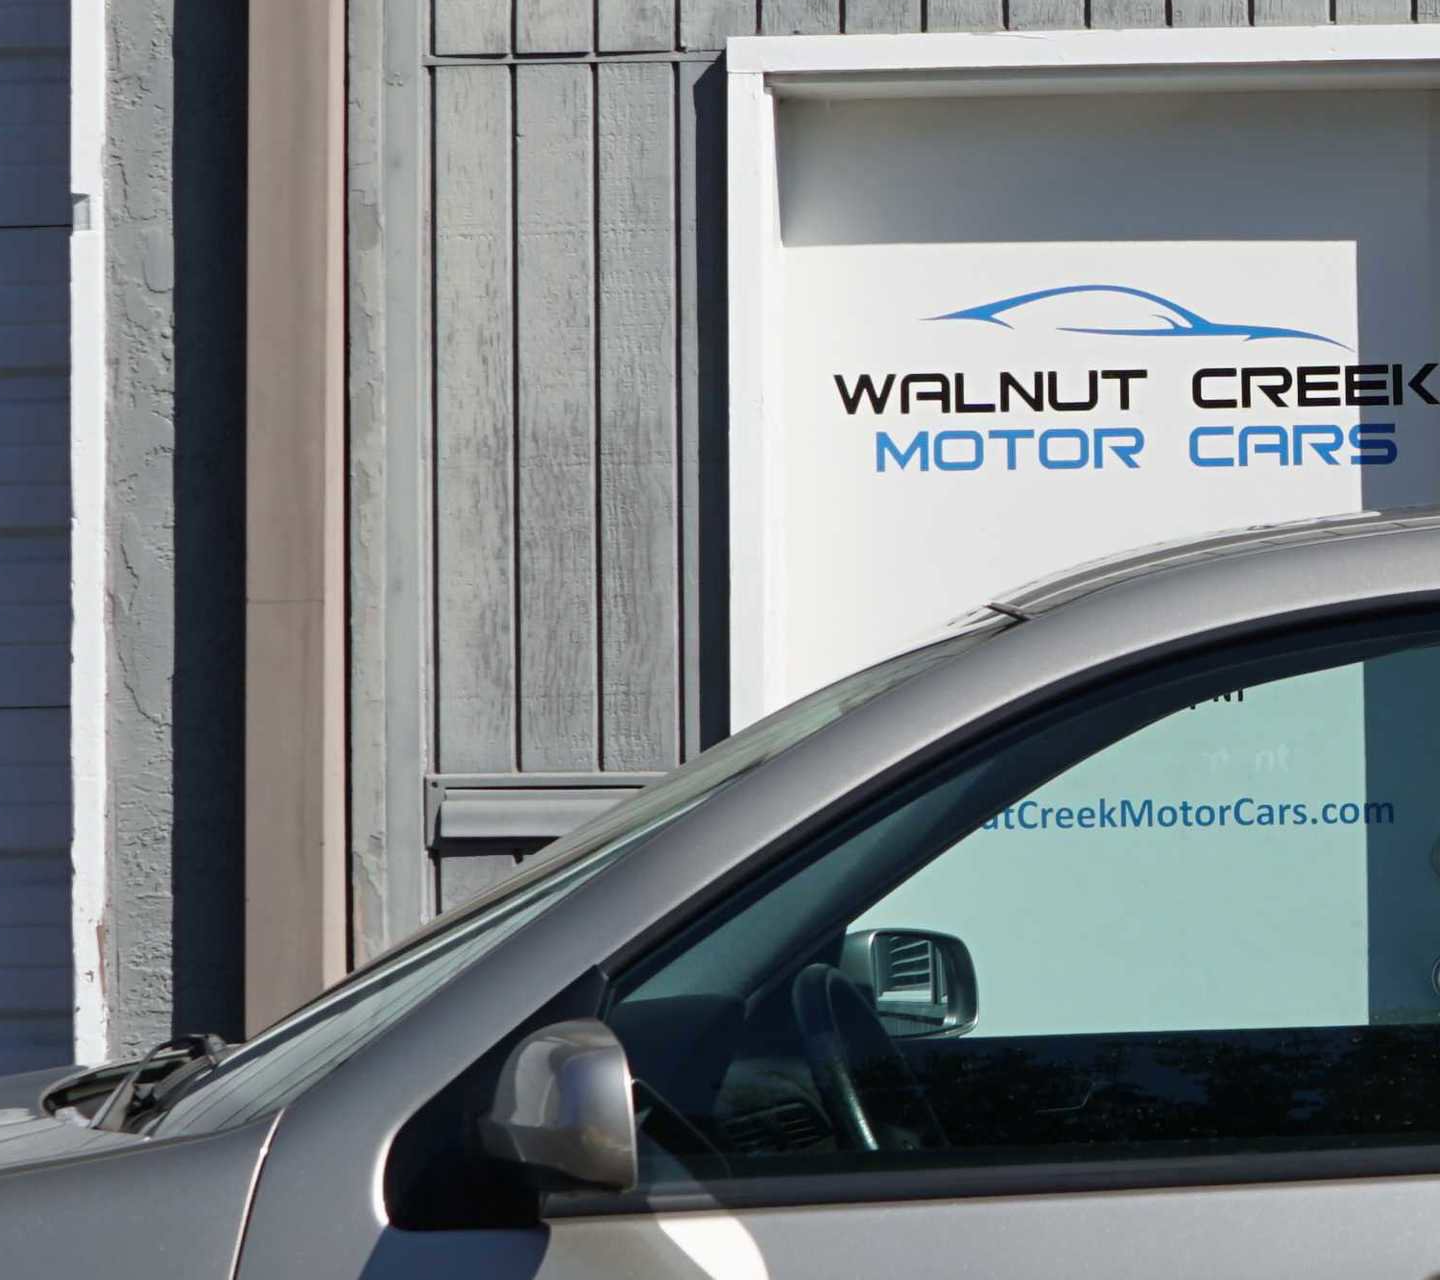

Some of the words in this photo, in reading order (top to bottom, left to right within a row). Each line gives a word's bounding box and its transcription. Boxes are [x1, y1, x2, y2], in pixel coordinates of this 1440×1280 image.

[834, 369, 1148, 415] WALNUT
[1192, 363, 1440, 409] CREEK
[876, 427, 1145, 471] MOTOR
[1189, 423, 1398, 467] CARS
